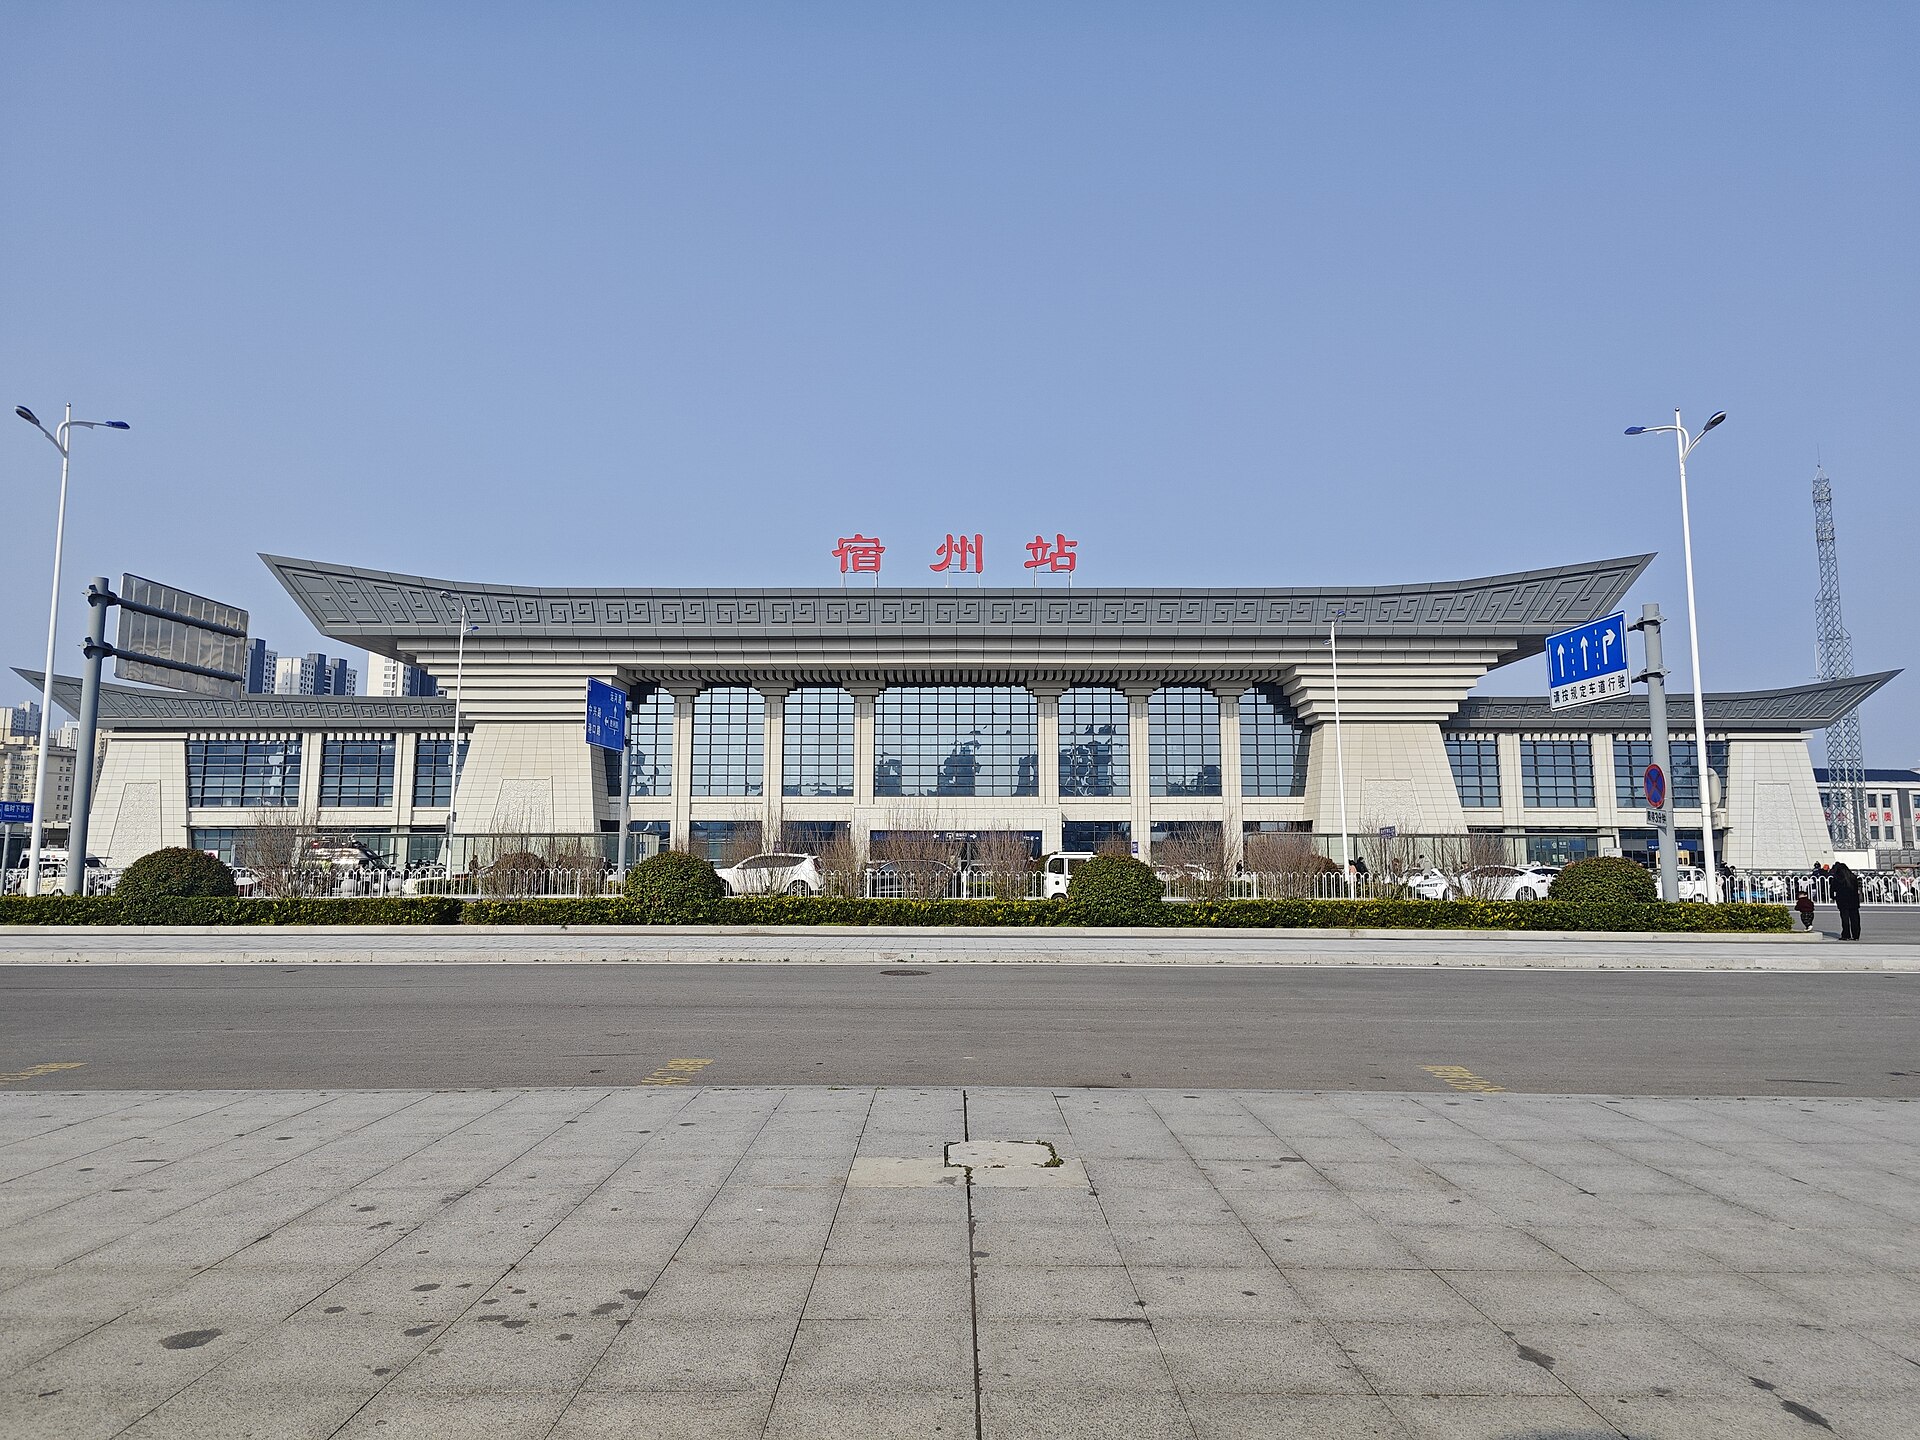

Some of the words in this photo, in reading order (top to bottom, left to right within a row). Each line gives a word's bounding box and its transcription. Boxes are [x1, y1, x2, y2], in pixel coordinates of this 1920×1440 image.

[831, 533, 1078, 573] 宿州站
[1553, 674, 1626, 704] 请按规定车道行驶
[1869, 811, 1892, 822] 优质
